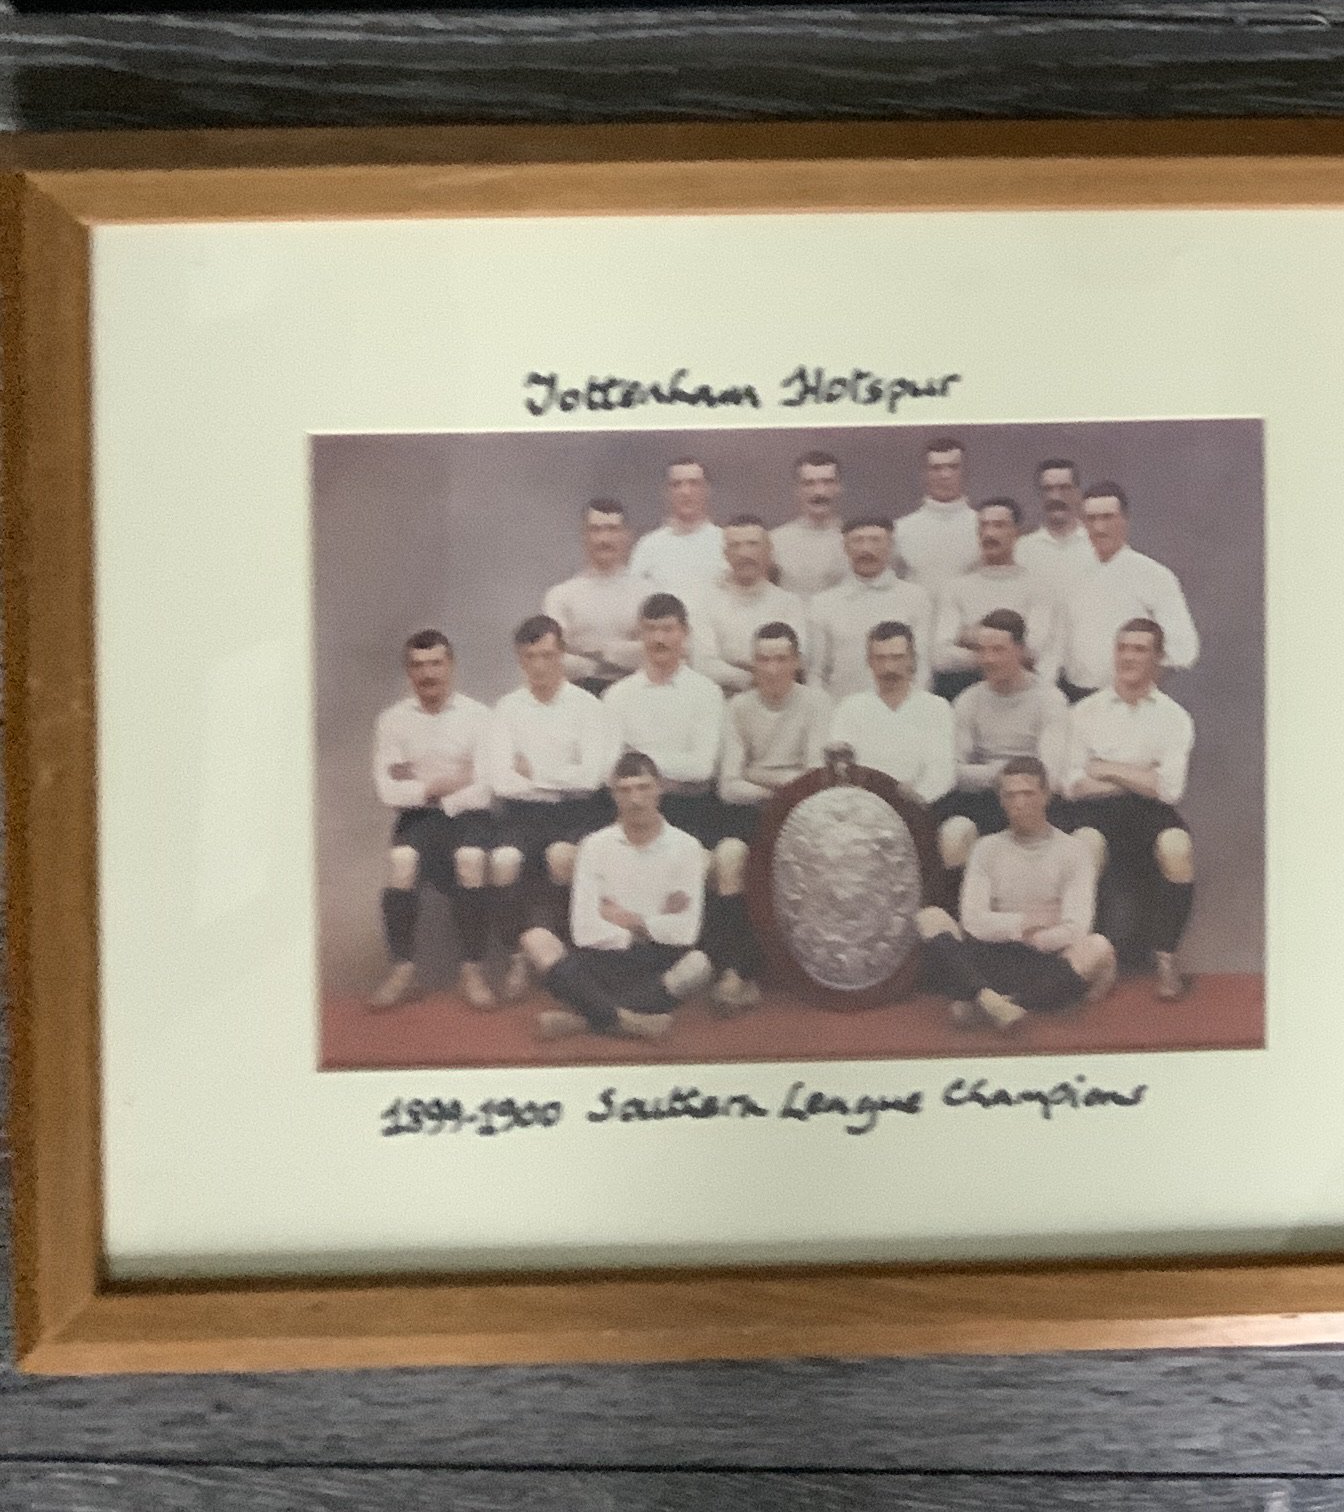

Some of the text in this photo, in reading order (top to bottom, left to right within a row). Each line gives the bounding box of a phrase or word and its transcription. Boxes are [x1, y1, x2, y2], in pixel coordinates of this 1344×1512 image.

[524, 363, 963, 417] Tottenham Hotspur
[585, 1085, 770, 1124] Southern
[776, 1079, 924, 1136] League
